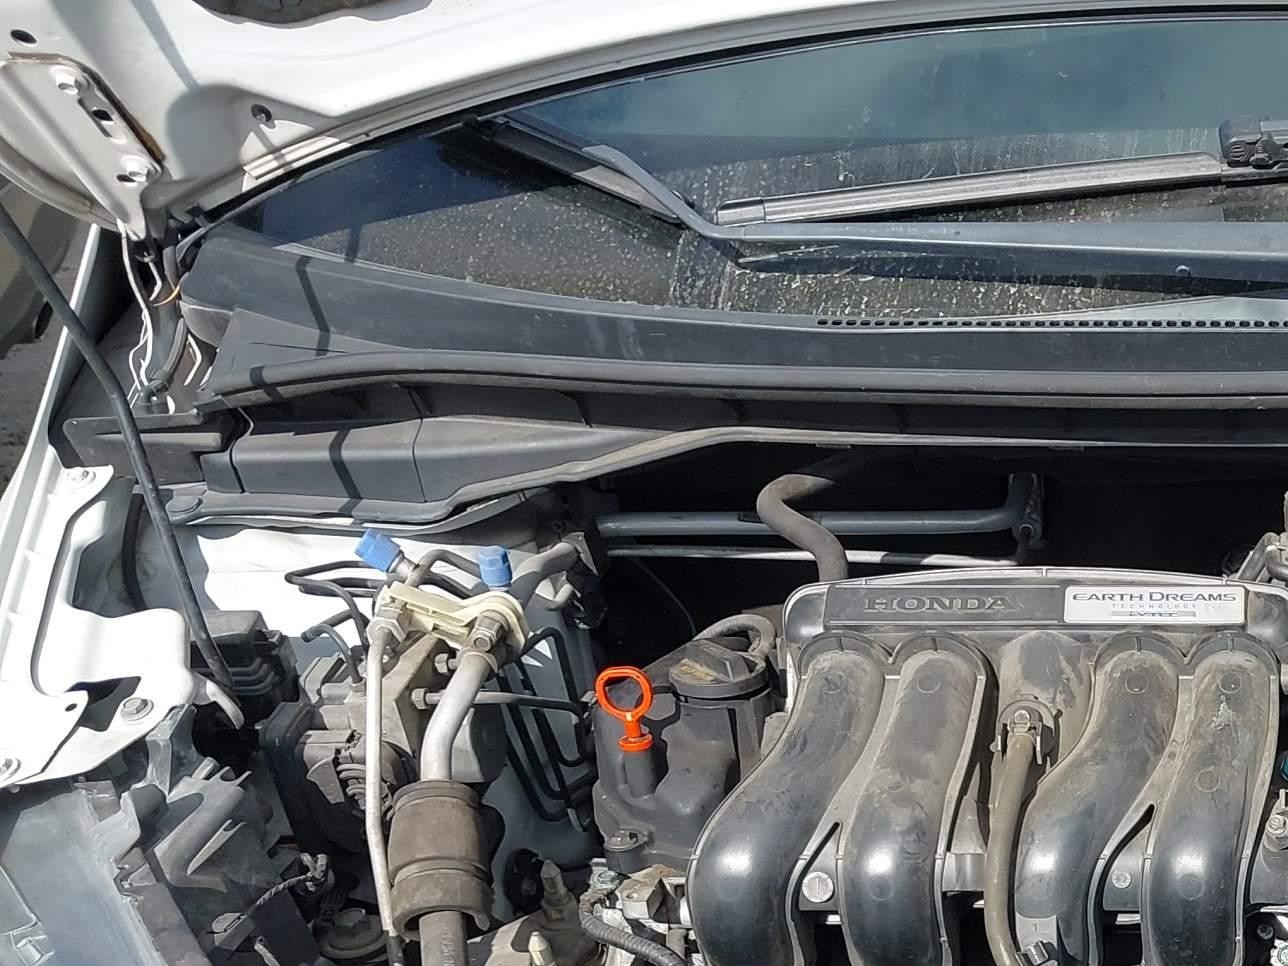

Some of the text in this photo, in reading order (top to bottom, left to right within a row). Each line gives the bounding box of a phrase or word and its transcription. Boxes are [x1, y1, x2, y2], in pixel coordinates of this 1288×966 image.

[1072, 591, 1237, 602] EARTH DREAMS
[864, 596, 1017, 613] HONDA
